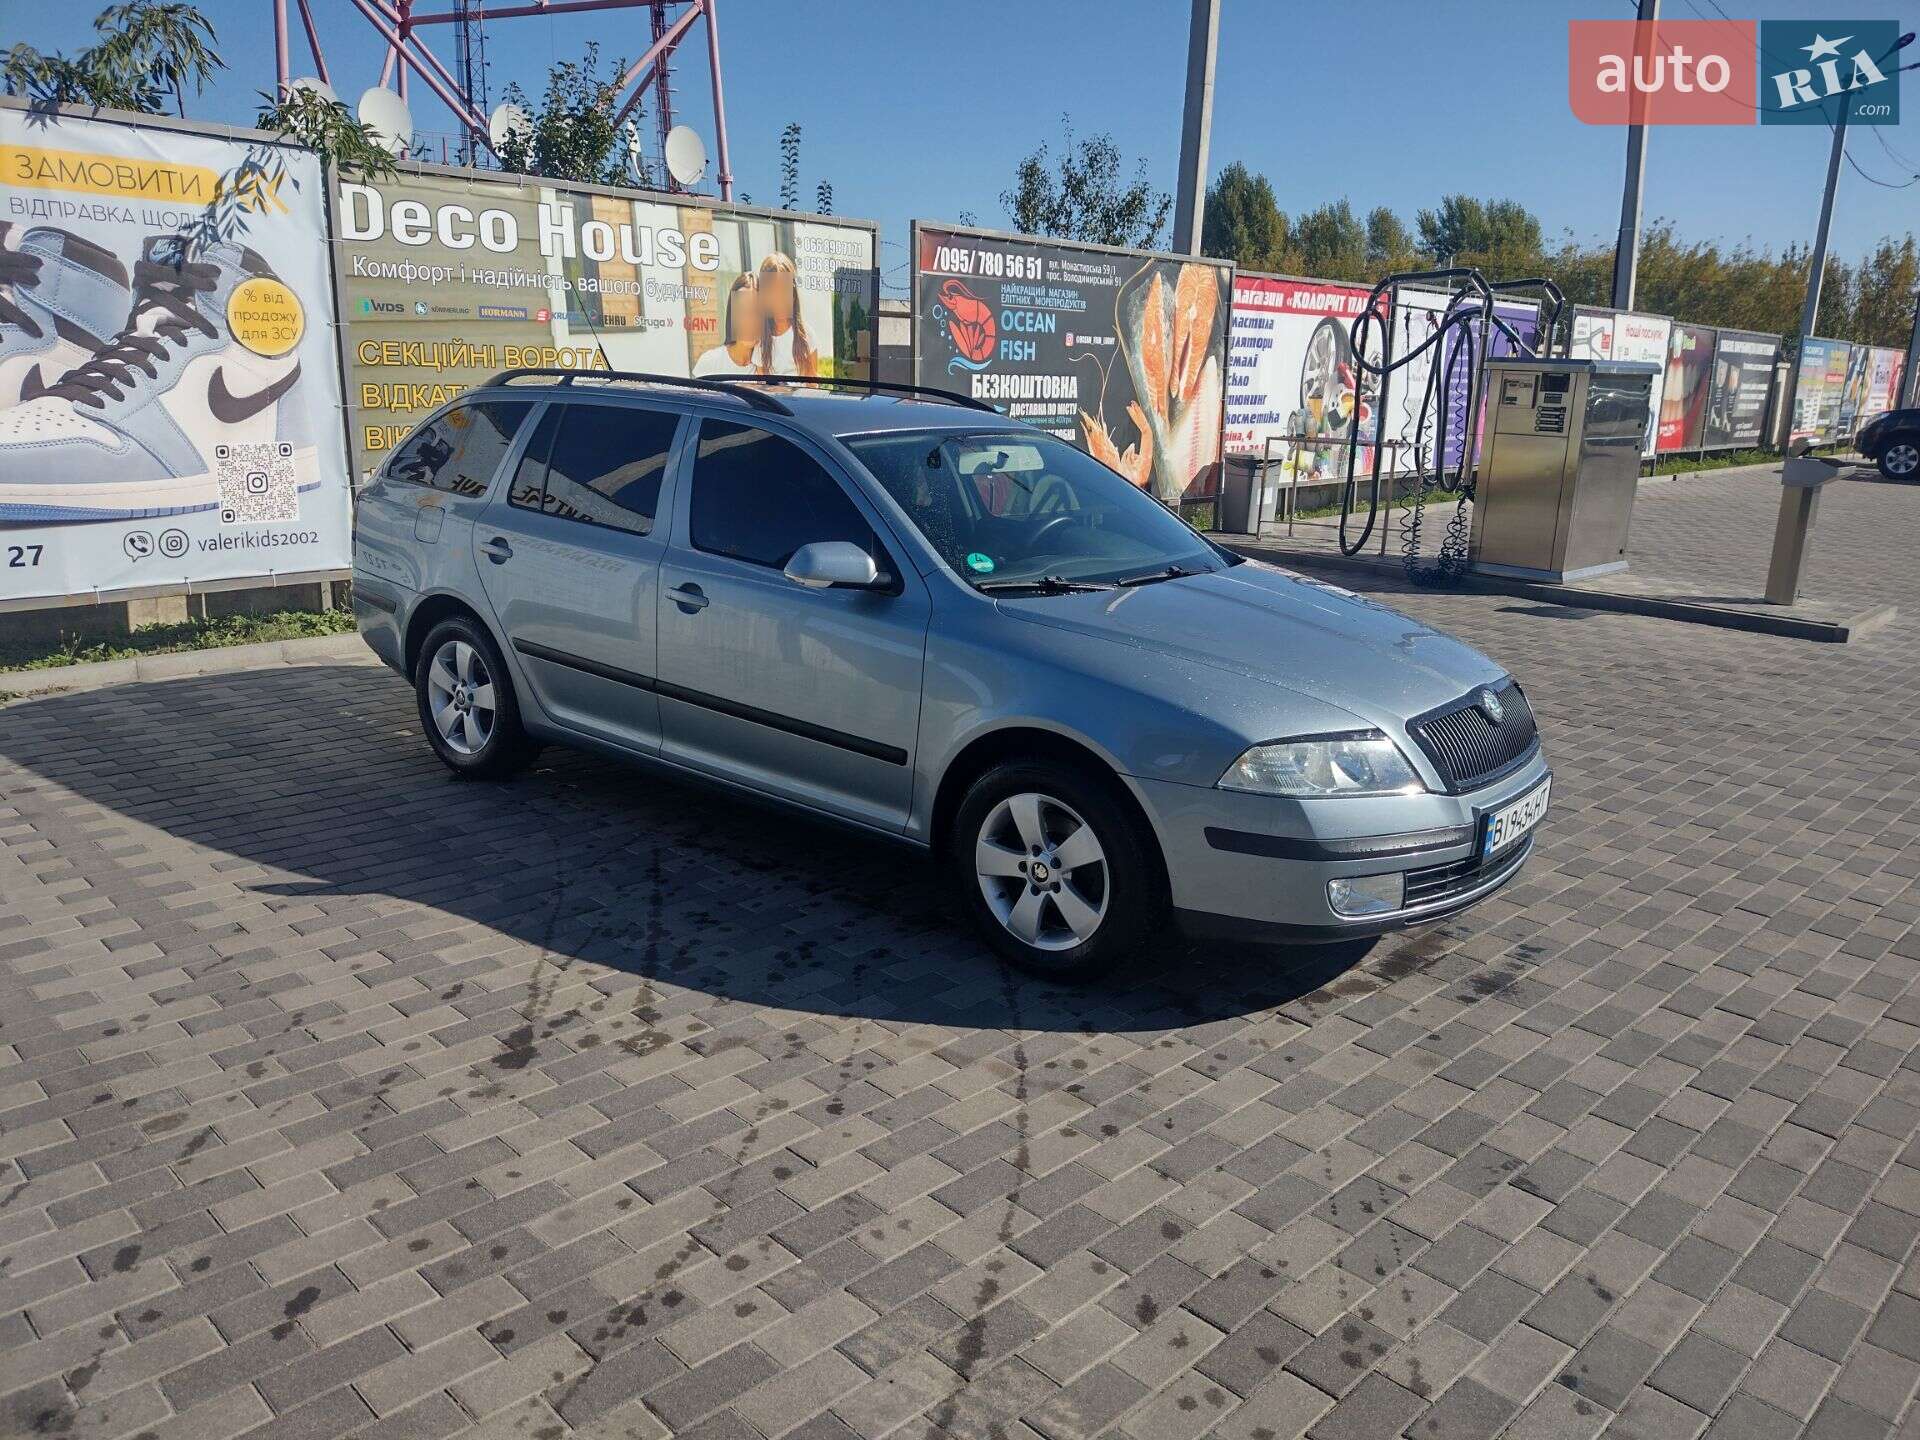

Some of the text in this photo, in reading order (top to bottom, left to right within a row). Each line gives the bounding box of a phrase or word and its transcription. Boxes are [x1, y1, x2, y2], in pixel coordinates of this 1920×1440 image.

[15, 154, 202, 197] ЗАМОВИТИ
[10, 197, 136, 225] ВІДПРАВКА
[340, 183, 721, 272] Deco House
[979, 252, 1003, 277] 780
[1006, 255, 1025, 279] 56
[1026, 257, 1042, 280] 51
[353, 255, 712, 305] Комфорт і надійність вашого будинку
[244, 289, 284, 304] % від
[371, 299, 405, 313] WDS
[234, 312, 297, 325] продажу
[1000, 310, 1056, 334] OCEAN
[241, 327, 298, 341] для ЗСУ
[358, 338, 609, 372] СЕКЦІЙНІ ВОРОТА
[1000, 340, 1036, 361] FISH
[971, 373, 1078, 399] БЕЗКОШТОВНА
[1009, 403, 1047, 418] ДОСТАВКА
[197, 530, 320, 552] valerikids2002
[8, 544, 44, 568] 27
